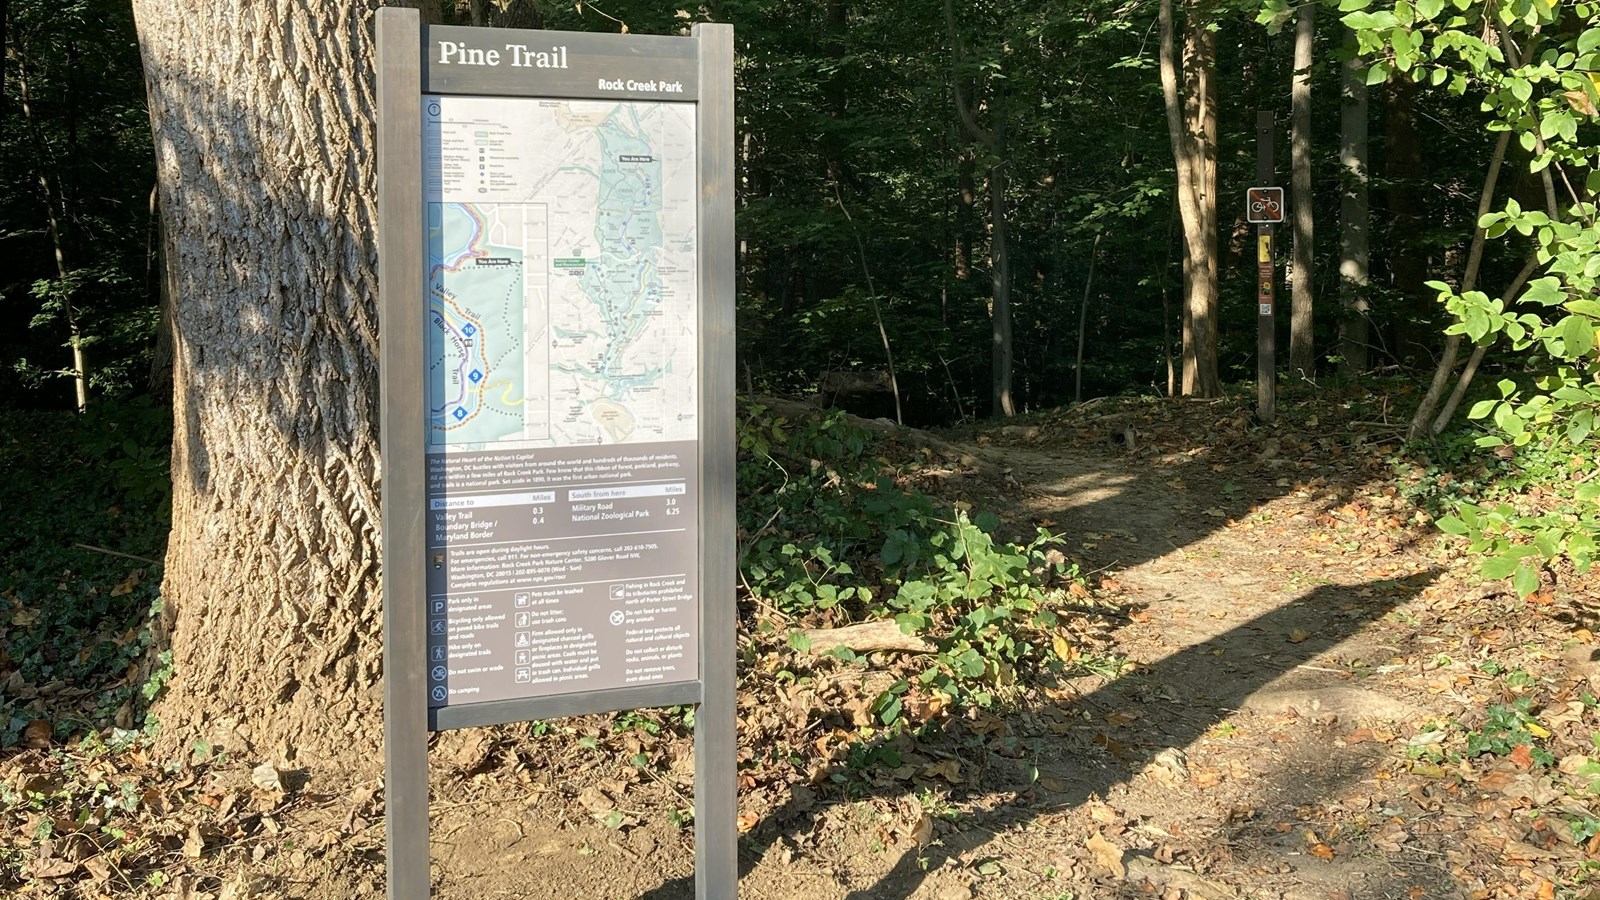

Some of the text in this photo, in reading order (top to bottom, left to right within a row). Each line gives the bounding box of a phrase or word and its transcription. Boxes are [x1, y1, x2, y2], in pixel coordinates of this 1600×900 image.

[438, 41, 568, 68] Pine Trail
[598, 79, 683, 92] Rock Creek Park
[436, 283, 481, 320] Valley Trail
[434, 318, 450, 335] Black
[451, 336, 464, 358] Horse
[436, 513, 456, 521] Valley
[601, 511, 634, 520] Zoological
[470, 521, 493, 529] Bridge
[436, 532, 468, 541] Maryland
[435, 602, 443, 612] P
